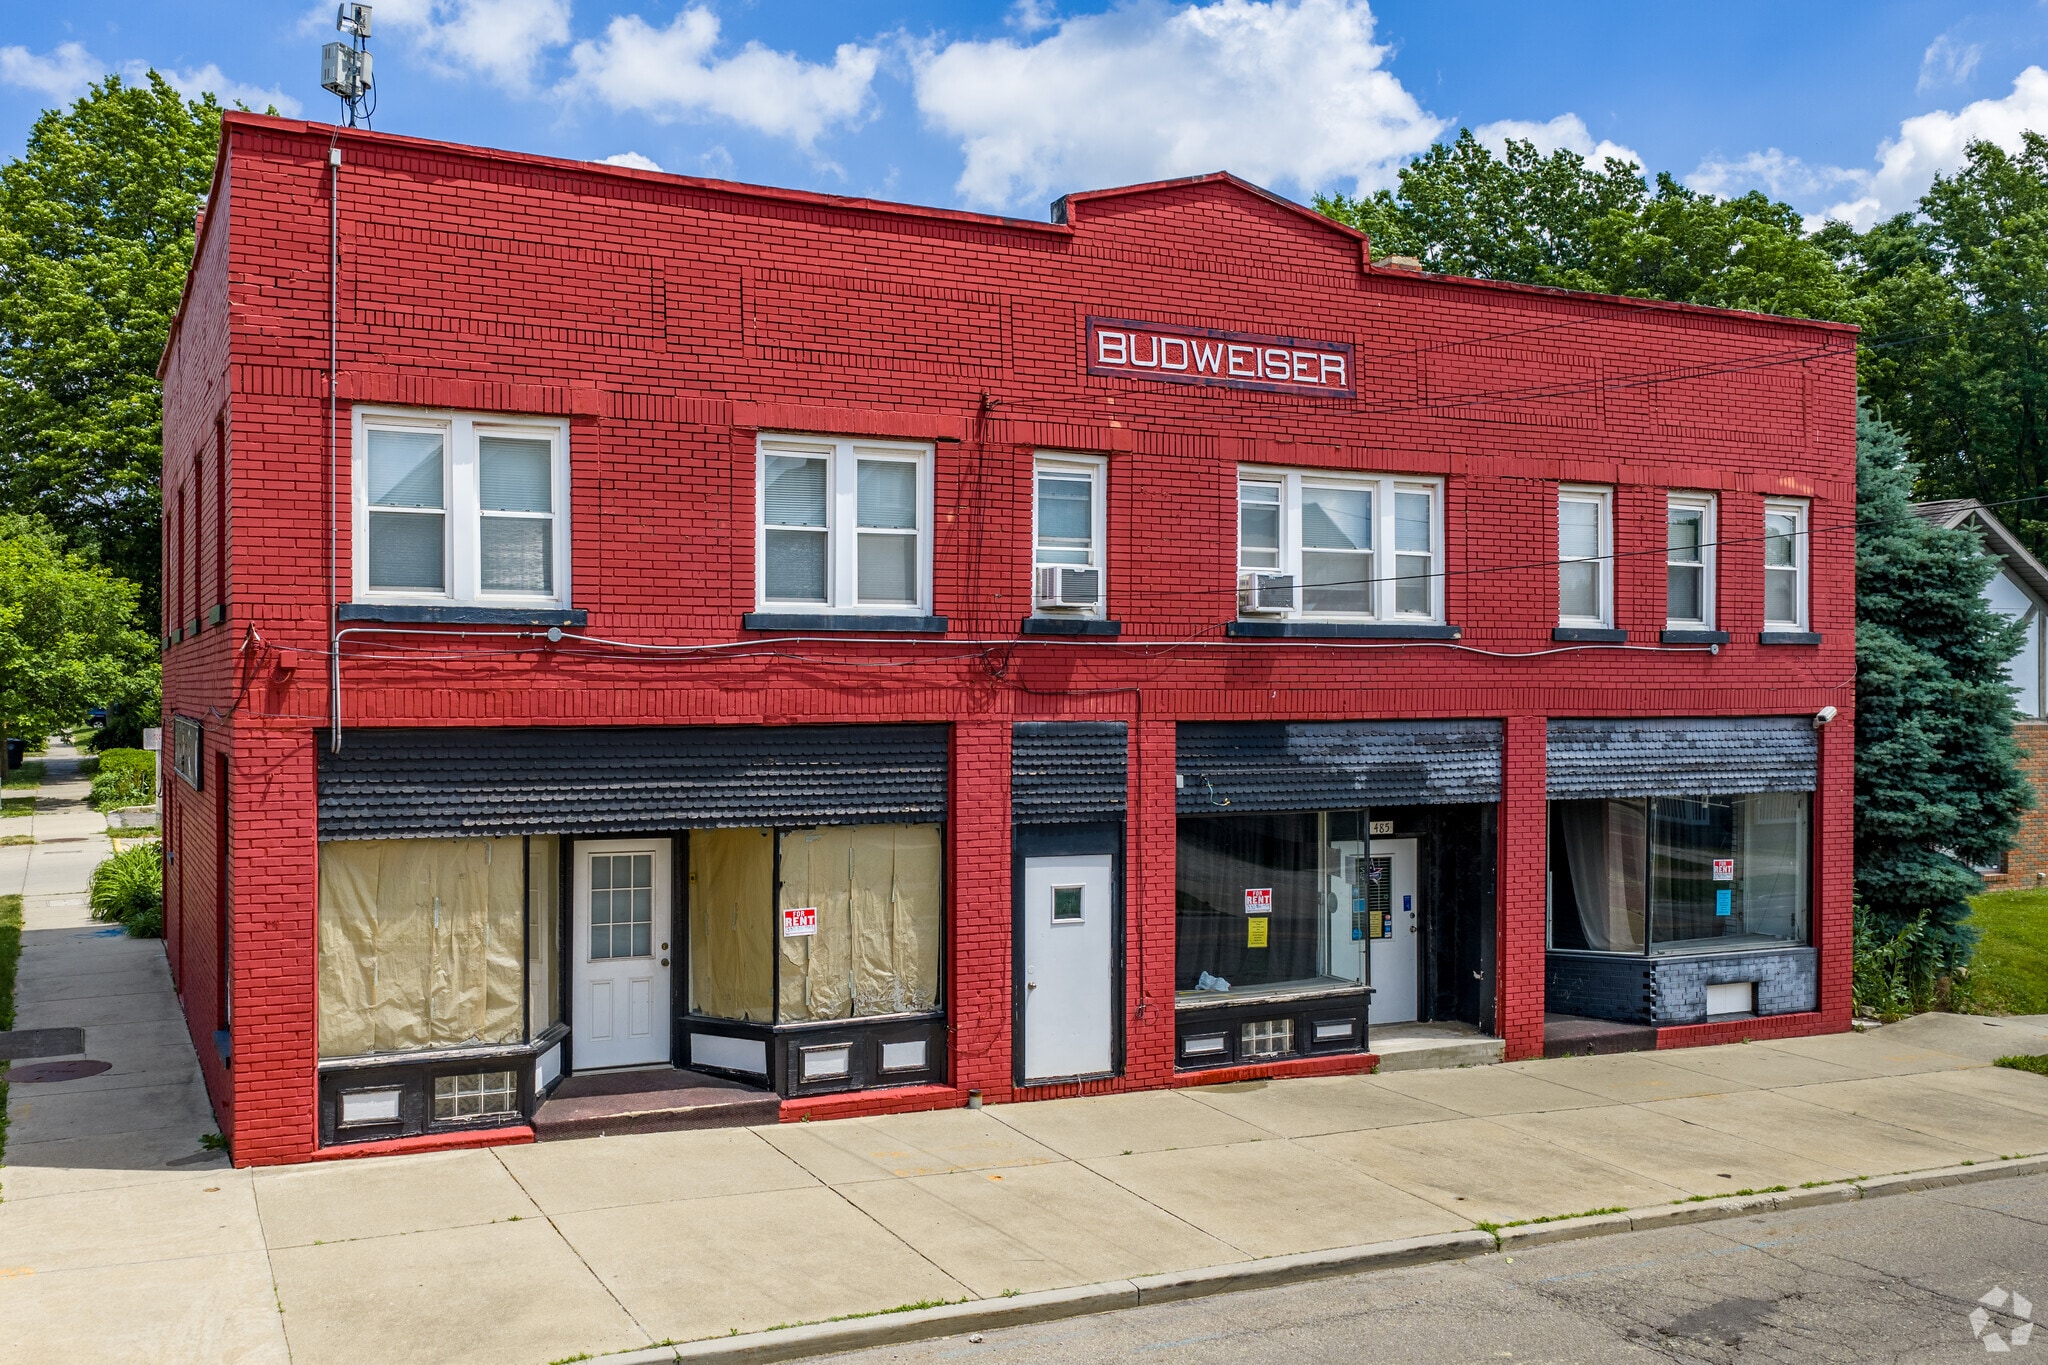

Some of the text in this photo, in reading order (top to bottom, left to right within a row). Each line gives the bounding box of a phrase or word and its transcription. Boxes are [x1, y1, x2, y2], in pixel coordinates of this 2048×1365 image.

[1098, 331, 1346, 386] BUDWEISER
[1374, 822, 1390, 834] 485
[1246, 896, 1270, 904] RENT
[785, 915, 815, 927] RENT
